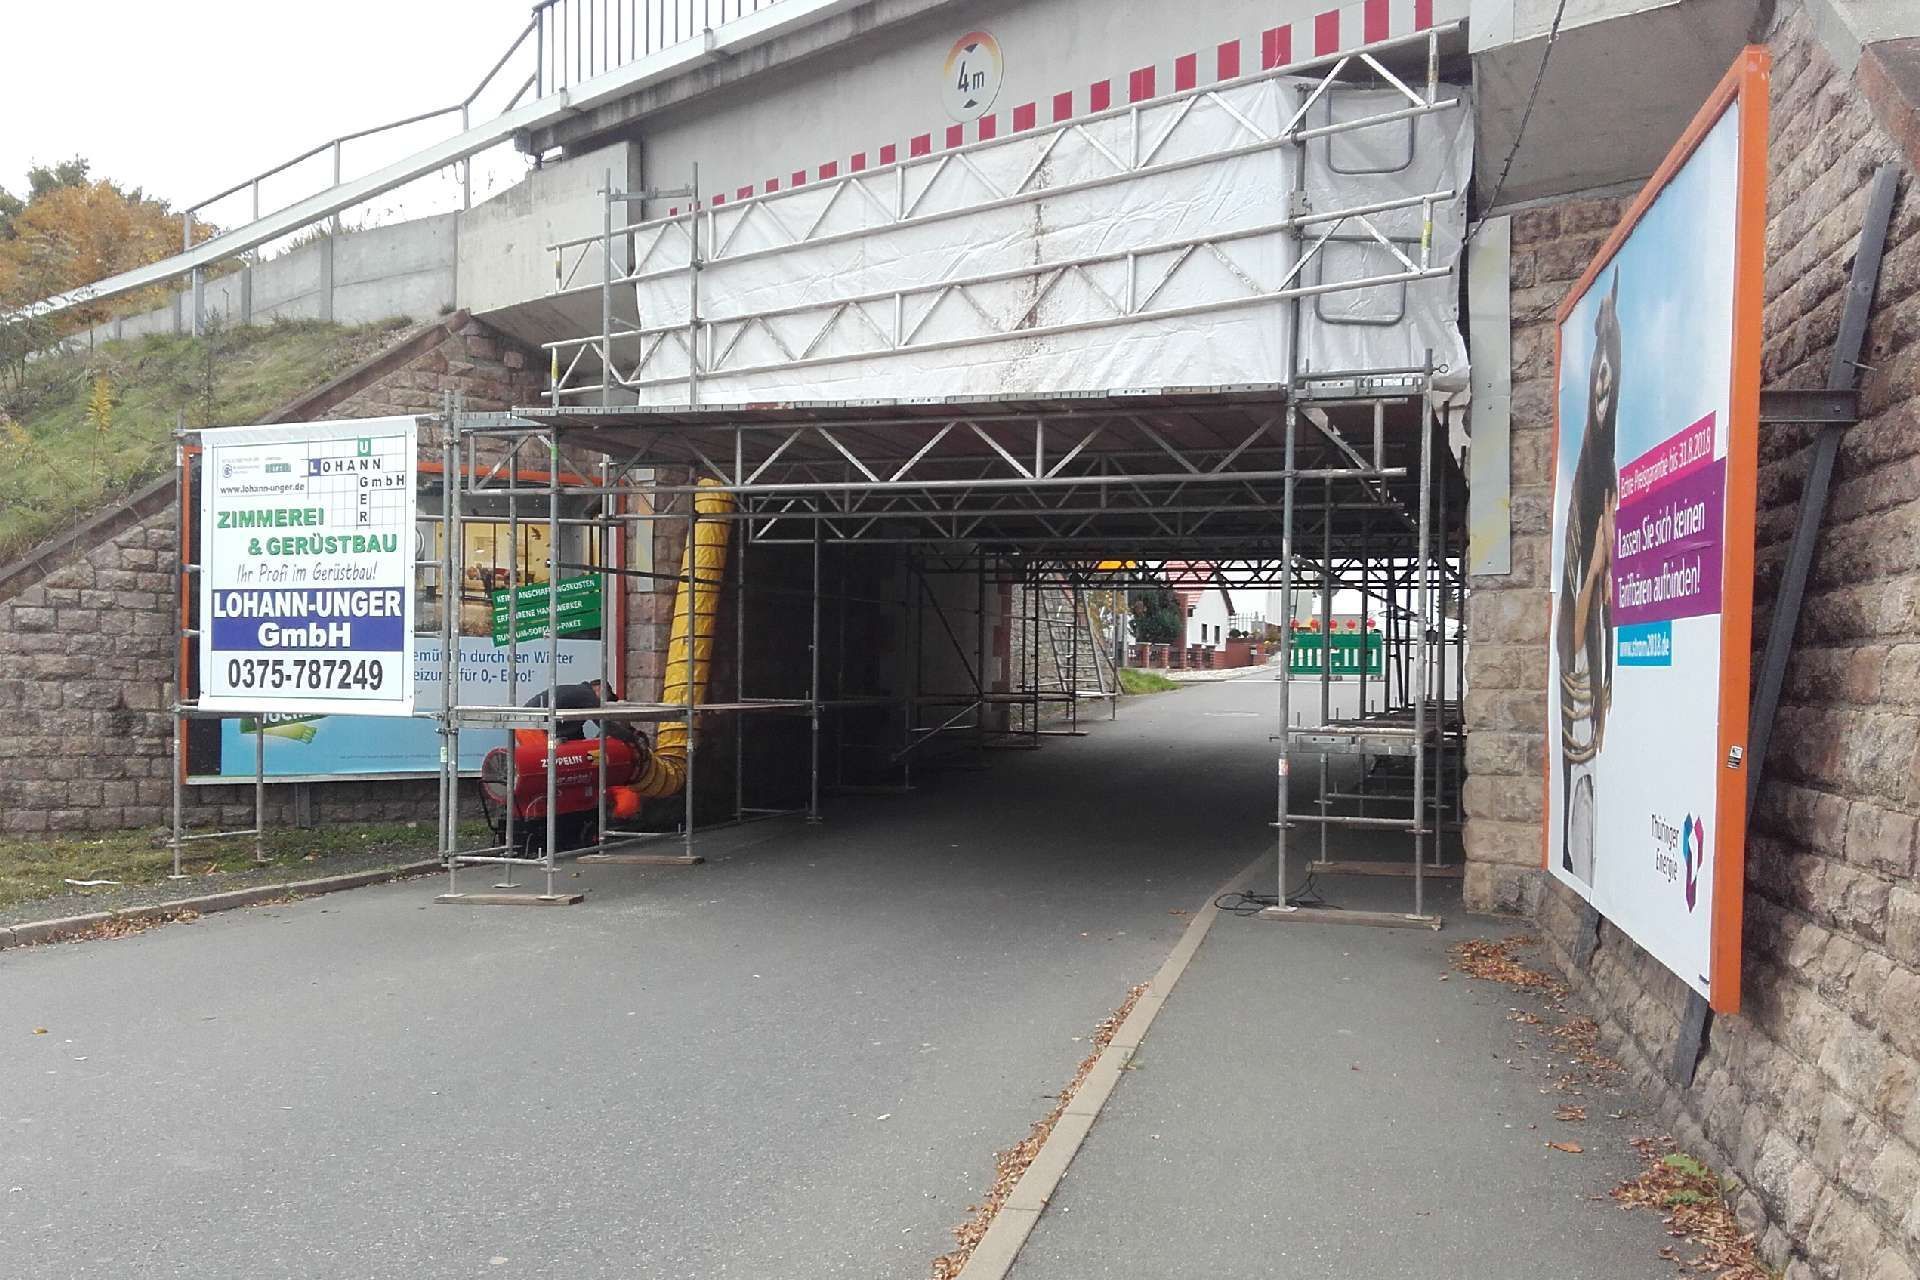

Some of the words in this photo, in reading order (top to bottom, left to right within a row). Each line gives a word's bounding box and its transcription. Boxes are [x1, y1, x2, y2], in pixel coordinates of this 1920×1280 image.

[1669, 446, 1678, 473] bis
[1679, 426, 1711, 468] 31.8.2018
[309, 458, 381, 474] LOHANN
[220, 483, 305, 495] www.lohann-unger.de
[360, 474, 404, 488] GmbH
[217, 508, 324, 529] ZIMMEREI
[1618, 528, 1641, 559] Lassen
[1642, 515, 1654, 551] Sie
[1655, 505, 1672, 547] sich
[1673, 498, 1705, 540] keinen
[248, 537, 263, 555] &
[266, 533, 397, 556] GERÜSTBAU
[237, 564, 254, 583] Ihr
[259, 562, 288, 583] Profi
[292, 564, 307, 582] im
[313, 560, 378, 582] Gerüstbau!
[1617, 572, 1652, 609] Tarifbären
[1653, 554, 1700, 602] aufbinden!
[518, 579, 595, 600] ANSCHAFNGSKOSTEN
[213, 590, 402, 618] LOHANN-UNGER
[496, 609, 536, 623] ERFRENE
[536, 601, 583, 616] HANWERKER
[258, 622, 350, 647] GmbH
[471, 650, 504, 664] durch
[507, 652, 529, 664] en
[534, 652, 573, 664] Witer
[228, 658, 383, 690] 0375-787249
[460, 668, 477, 682] für
[1651, 813, 1679, 851] Thüringer
[1656, 847, 1678, 883] Energie
